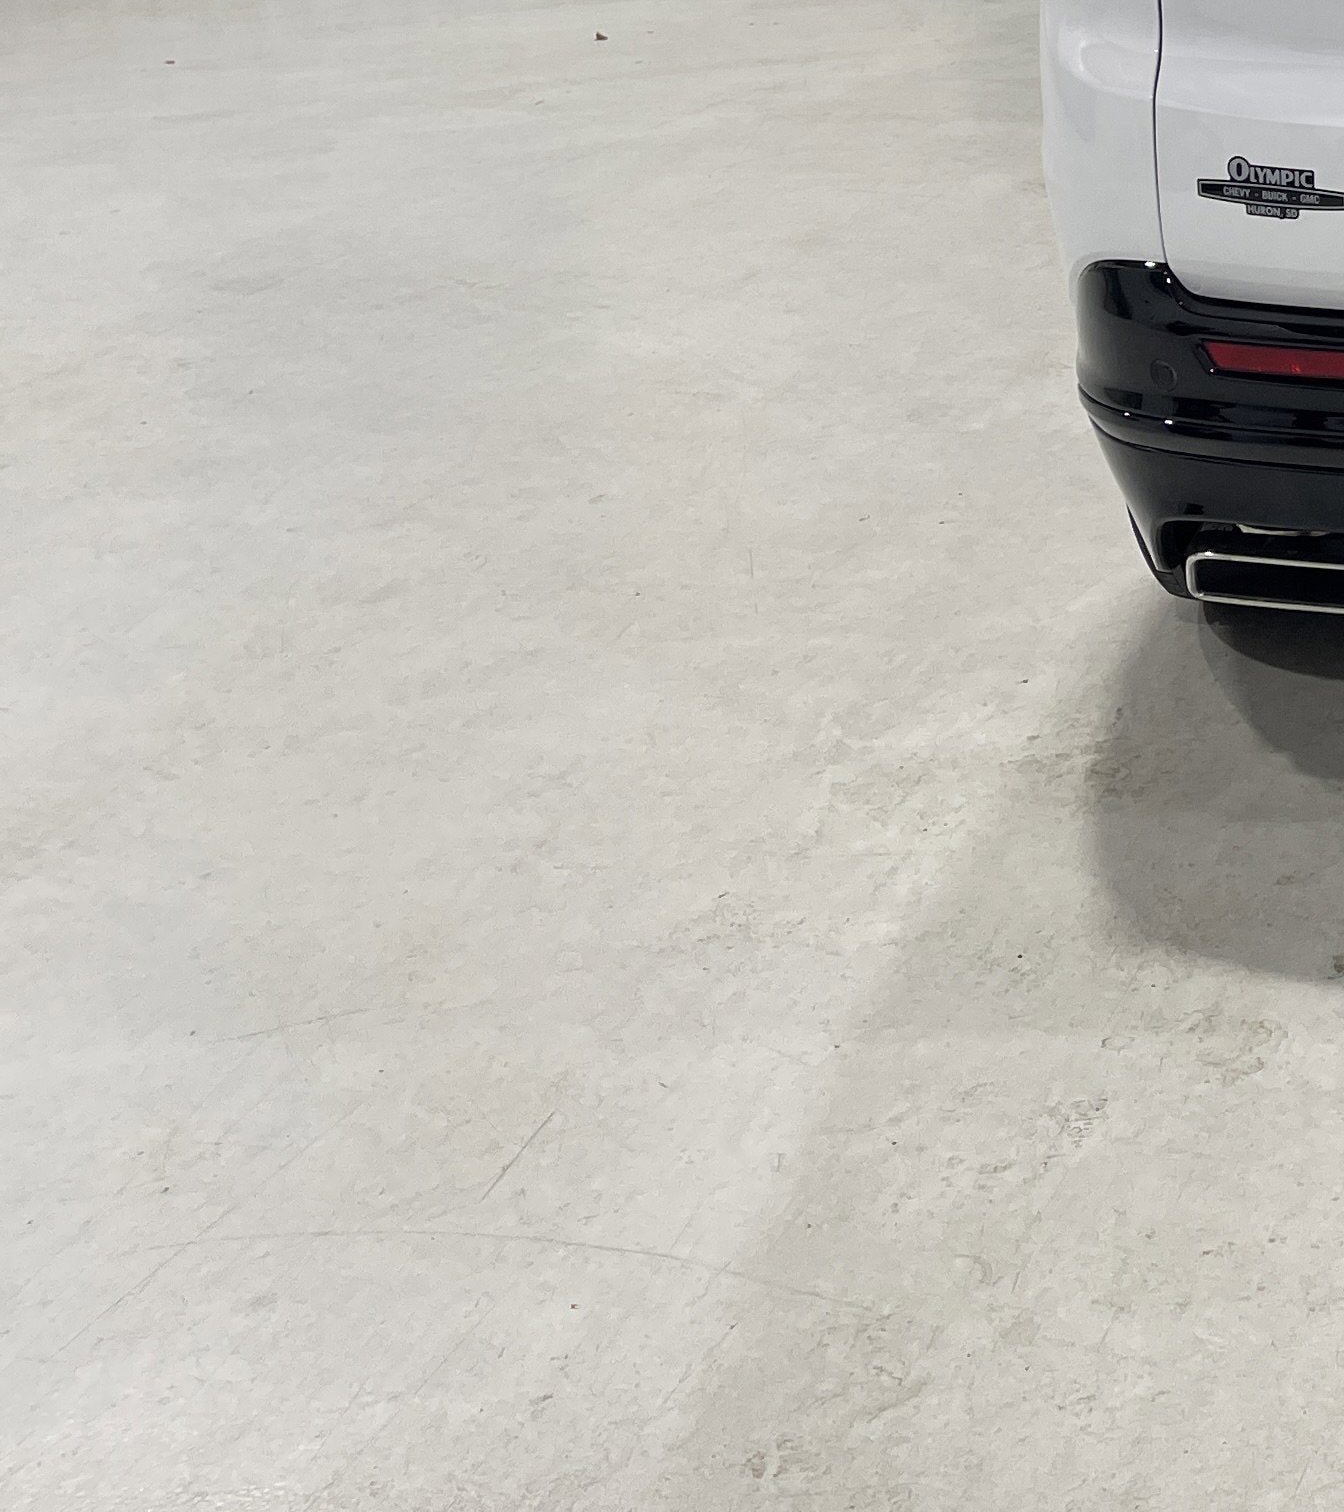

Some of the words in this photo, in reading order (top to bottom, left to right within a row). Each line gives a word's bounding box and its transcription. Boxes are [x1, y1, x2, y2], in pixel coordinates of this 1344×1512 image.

[1229, 158, 1313, 188] OLYMPIC
[1223, 186, 1251, 199] CHEVY
[1261, 190, 1288, 203] BUICK
[1300, 194, 1320, 205] GMC
[1247, 204, 1284, 218] HURON,
[1286, 208, 1298, 218] SD
